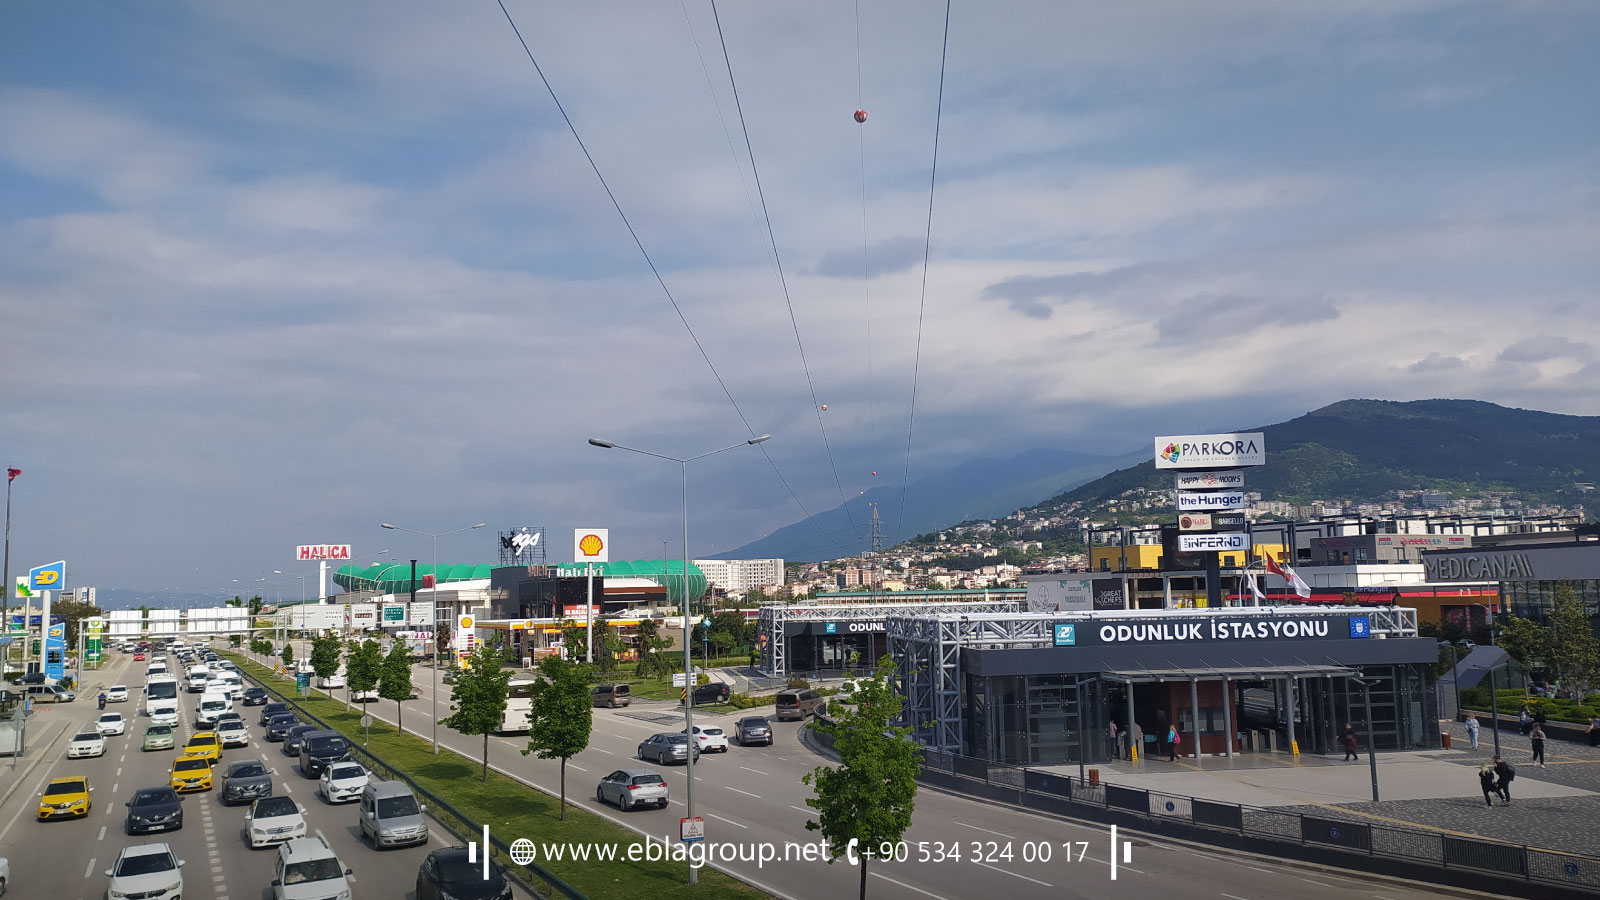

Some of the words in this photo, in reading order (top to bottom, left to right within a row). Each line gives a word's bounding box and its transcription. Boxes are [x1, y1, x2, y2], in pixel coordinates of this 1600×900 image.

[1182, 440, 1258, 457] PARKORA
[1181, 476, 1200, 485] HAPPY
[1180, 497, 1197, 505] the
[1198, 495, 1242, 506] Hunger
[1218, 517, 1244, 525] BARGELLO
[849, 622, 886, 632] ODUNL
[1100, 624, 1203, 642] ODUNLUK
[1211, 619, 1329, 640] İSTASYONU
